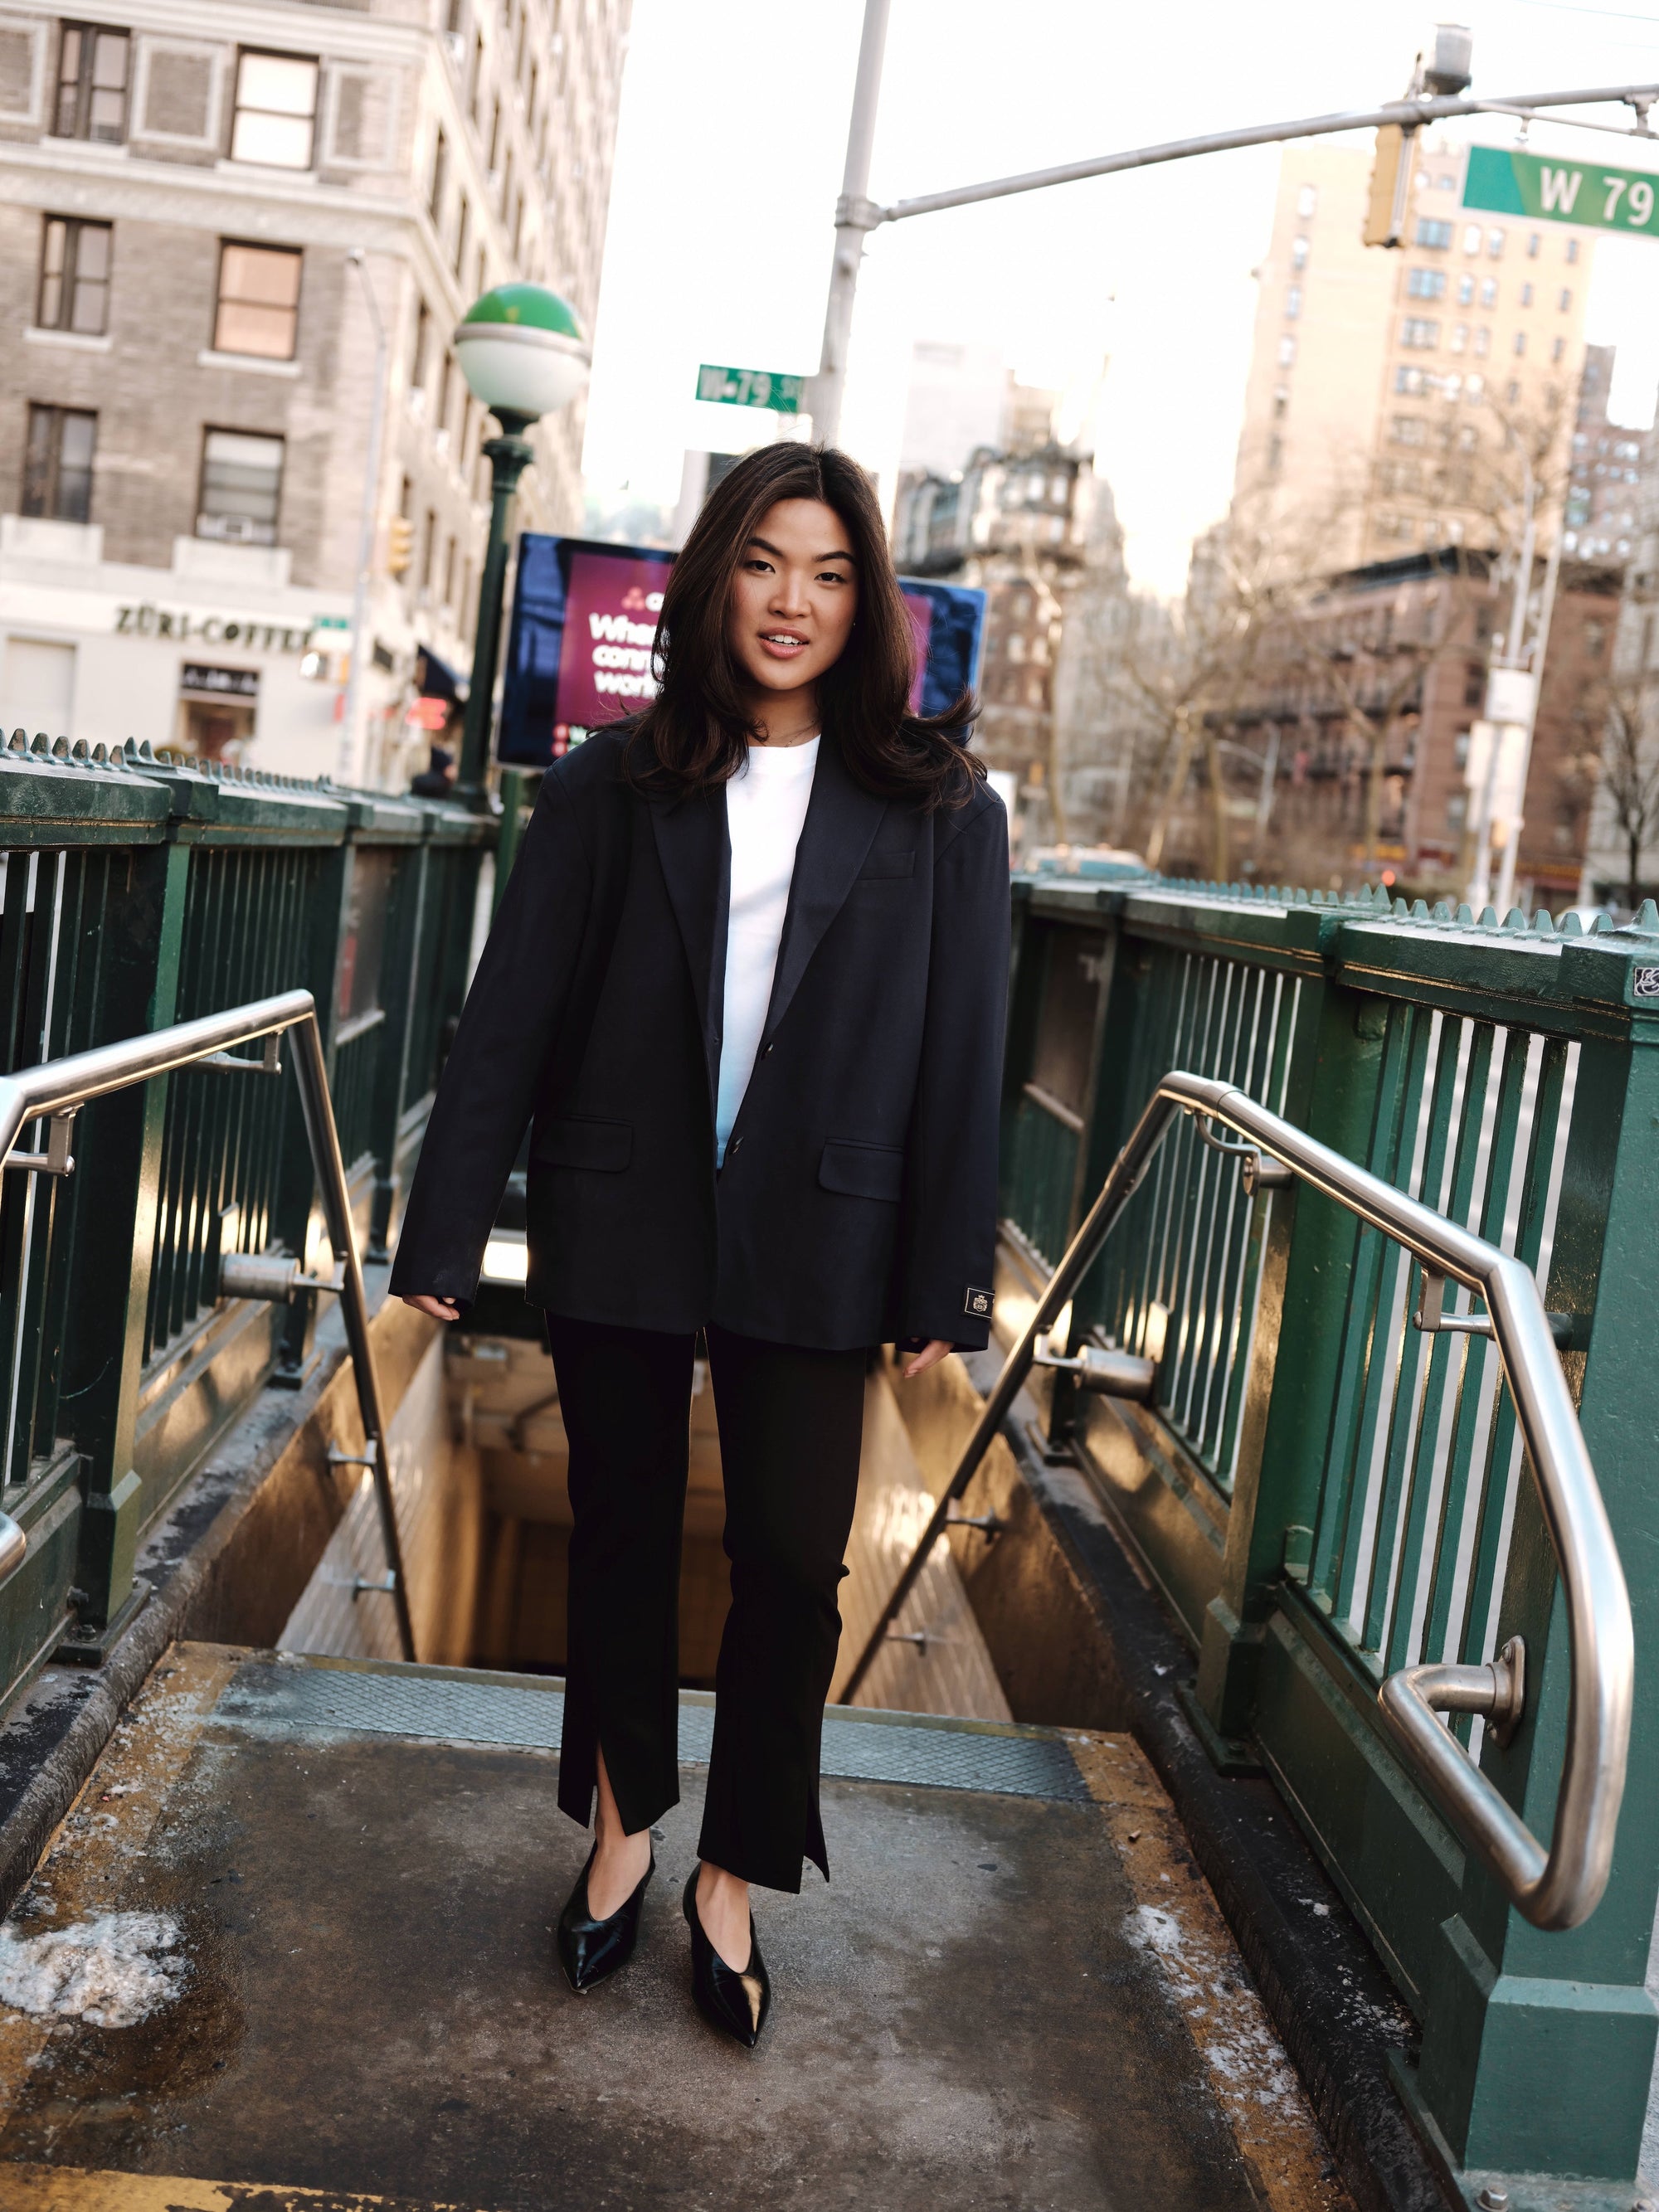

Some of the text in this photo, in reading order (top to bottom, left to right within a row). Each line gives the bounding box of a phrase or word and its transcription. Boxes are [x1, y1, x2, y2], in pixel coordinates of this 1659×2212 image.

[1540, 166, 1655, 226] W 79
[700, 367, 729, 401] W
[736, 371, 772, 406] 79
